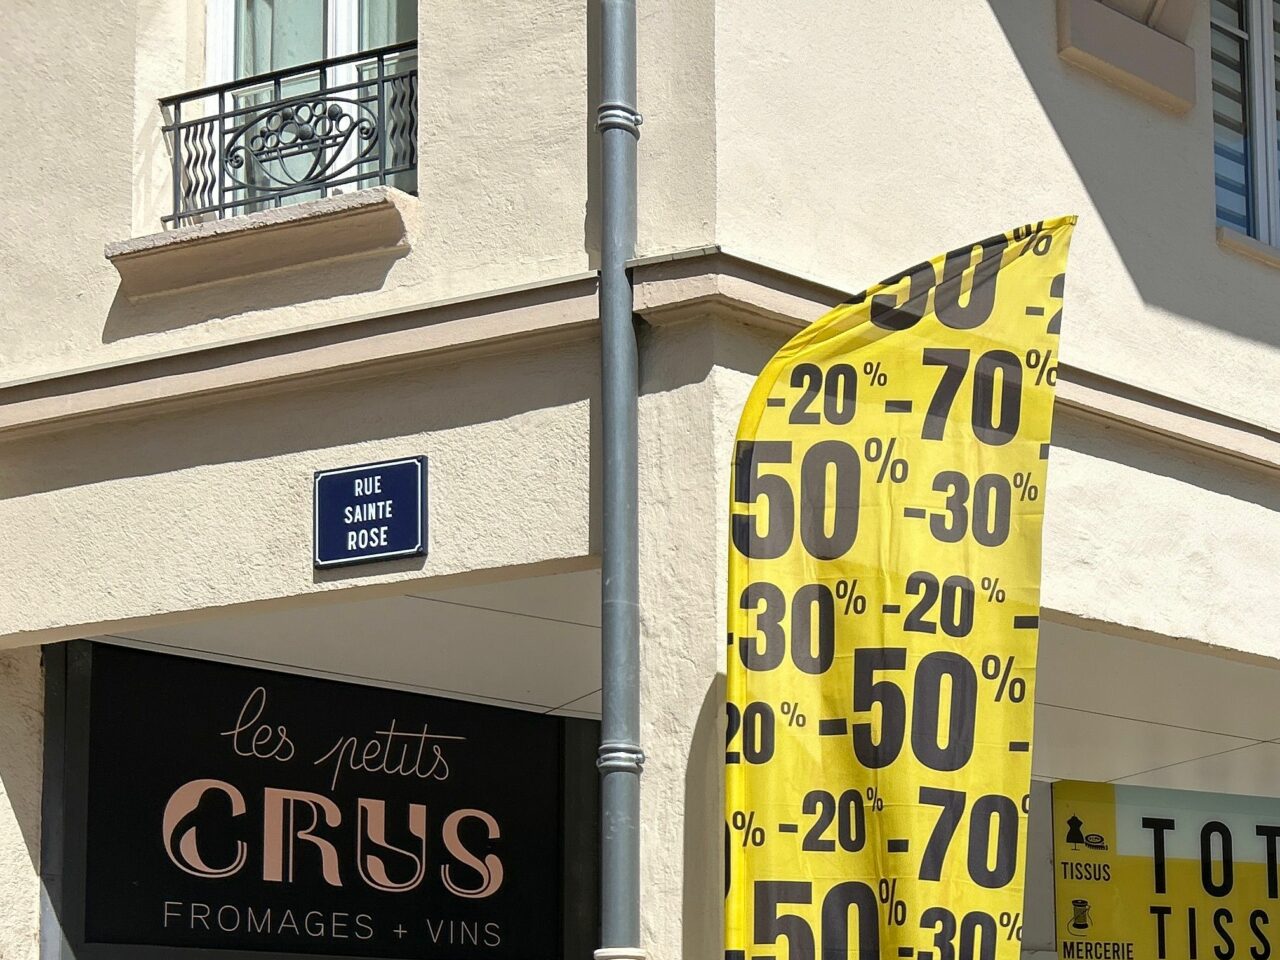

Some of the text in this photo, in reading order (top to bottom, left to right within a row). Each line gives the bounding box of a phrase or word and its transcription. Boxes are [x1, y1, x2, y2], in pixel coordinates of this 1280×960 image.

[766, 361, 887, 425] -20%
[884, 348, 1058, 446] -70%
[344, 500, 393, 524] SAINTE
[355, 475, 382, 497] RUE
[731, 437, 909, 560] 50%
[903, 471, 1038, 547] -30%
[347, 526, 388, 551] ROSE
[882, 571, 1006, 637] -20%
[220, 686, 466, 791] les petits
[818, 647, 1026, 772] -50%
[162, 778, 504, 899] CRUS
[778, 786, 883, 853] -20%
[1061, 861, 1111, 882] TISSUS
[163, 901, 501, 947] FROMAGES + VINS
[1063, 941, 1134, 960] MERCERIE
